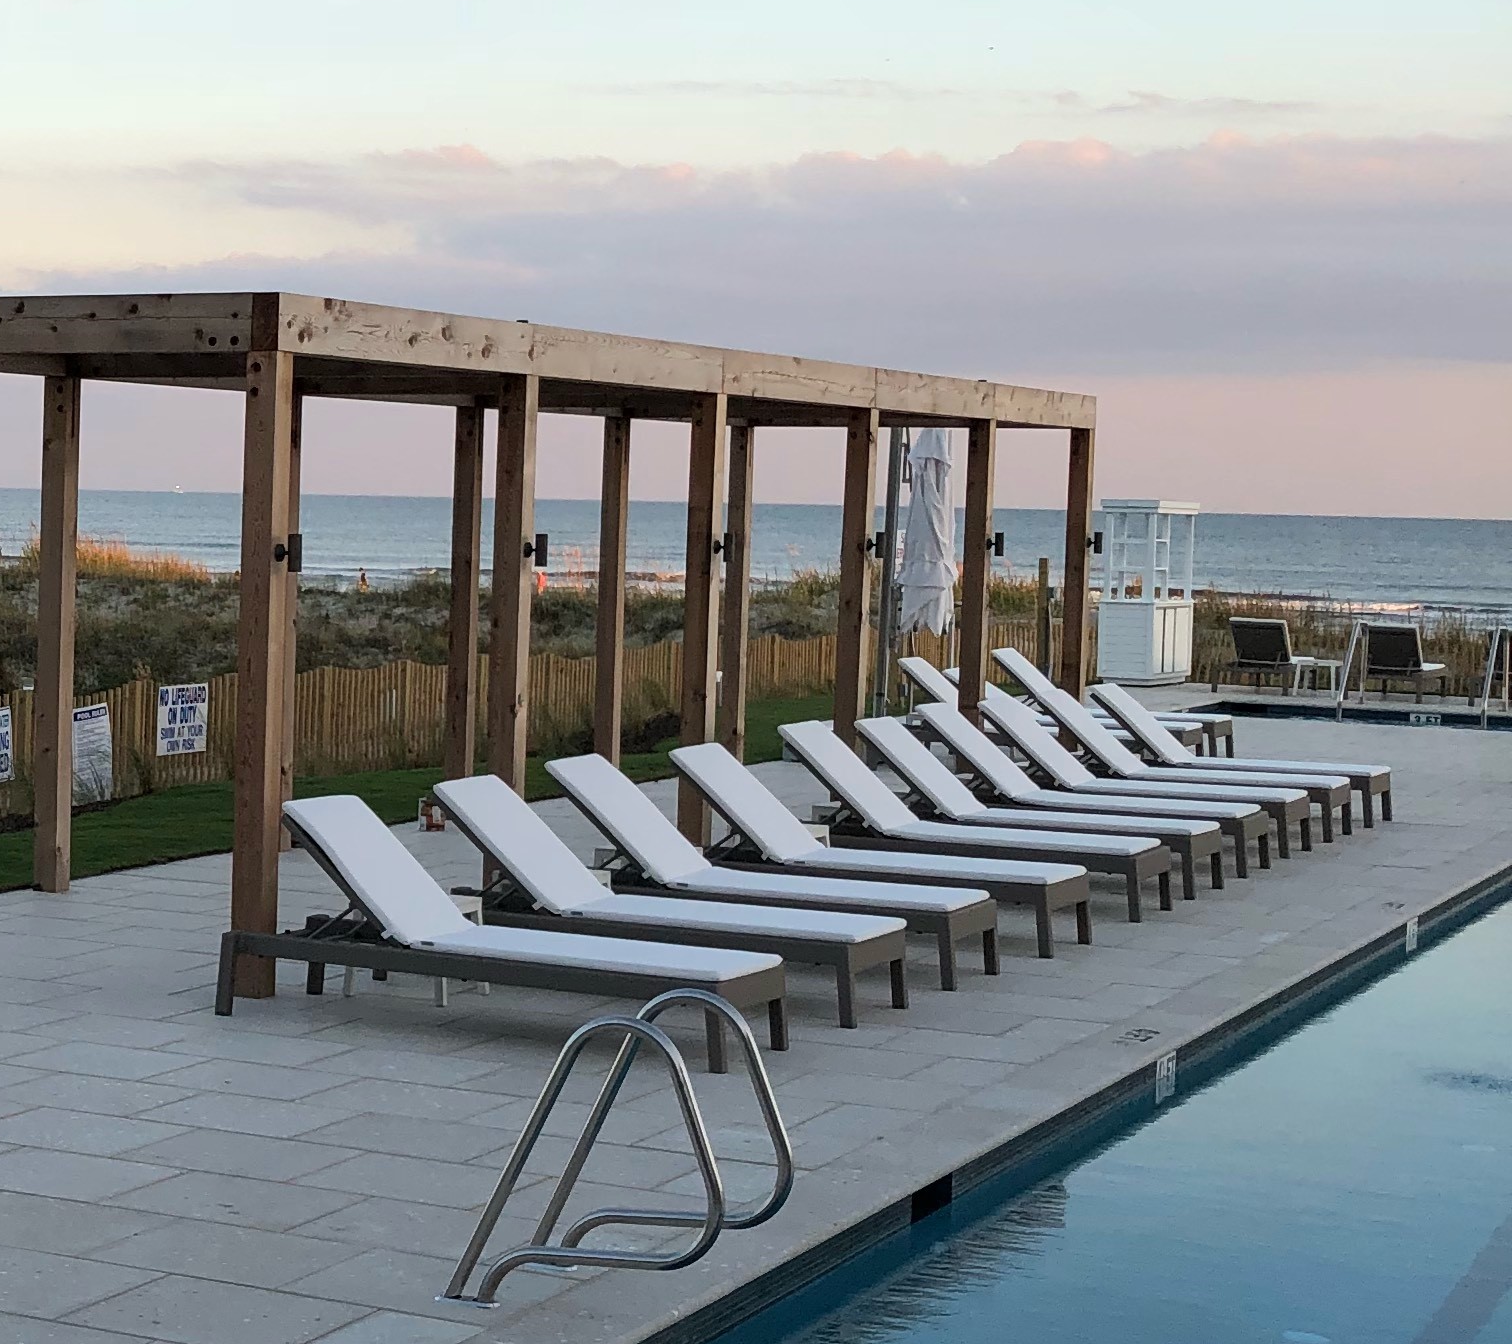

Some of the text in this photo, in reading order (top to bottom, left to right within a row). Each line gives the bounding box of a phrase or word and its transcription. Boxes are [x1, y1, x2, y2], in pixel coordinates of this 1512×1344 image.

[159, 685, 206, 706] NO LIFEGUARD
[180, 705, 197, 724] DUTY
